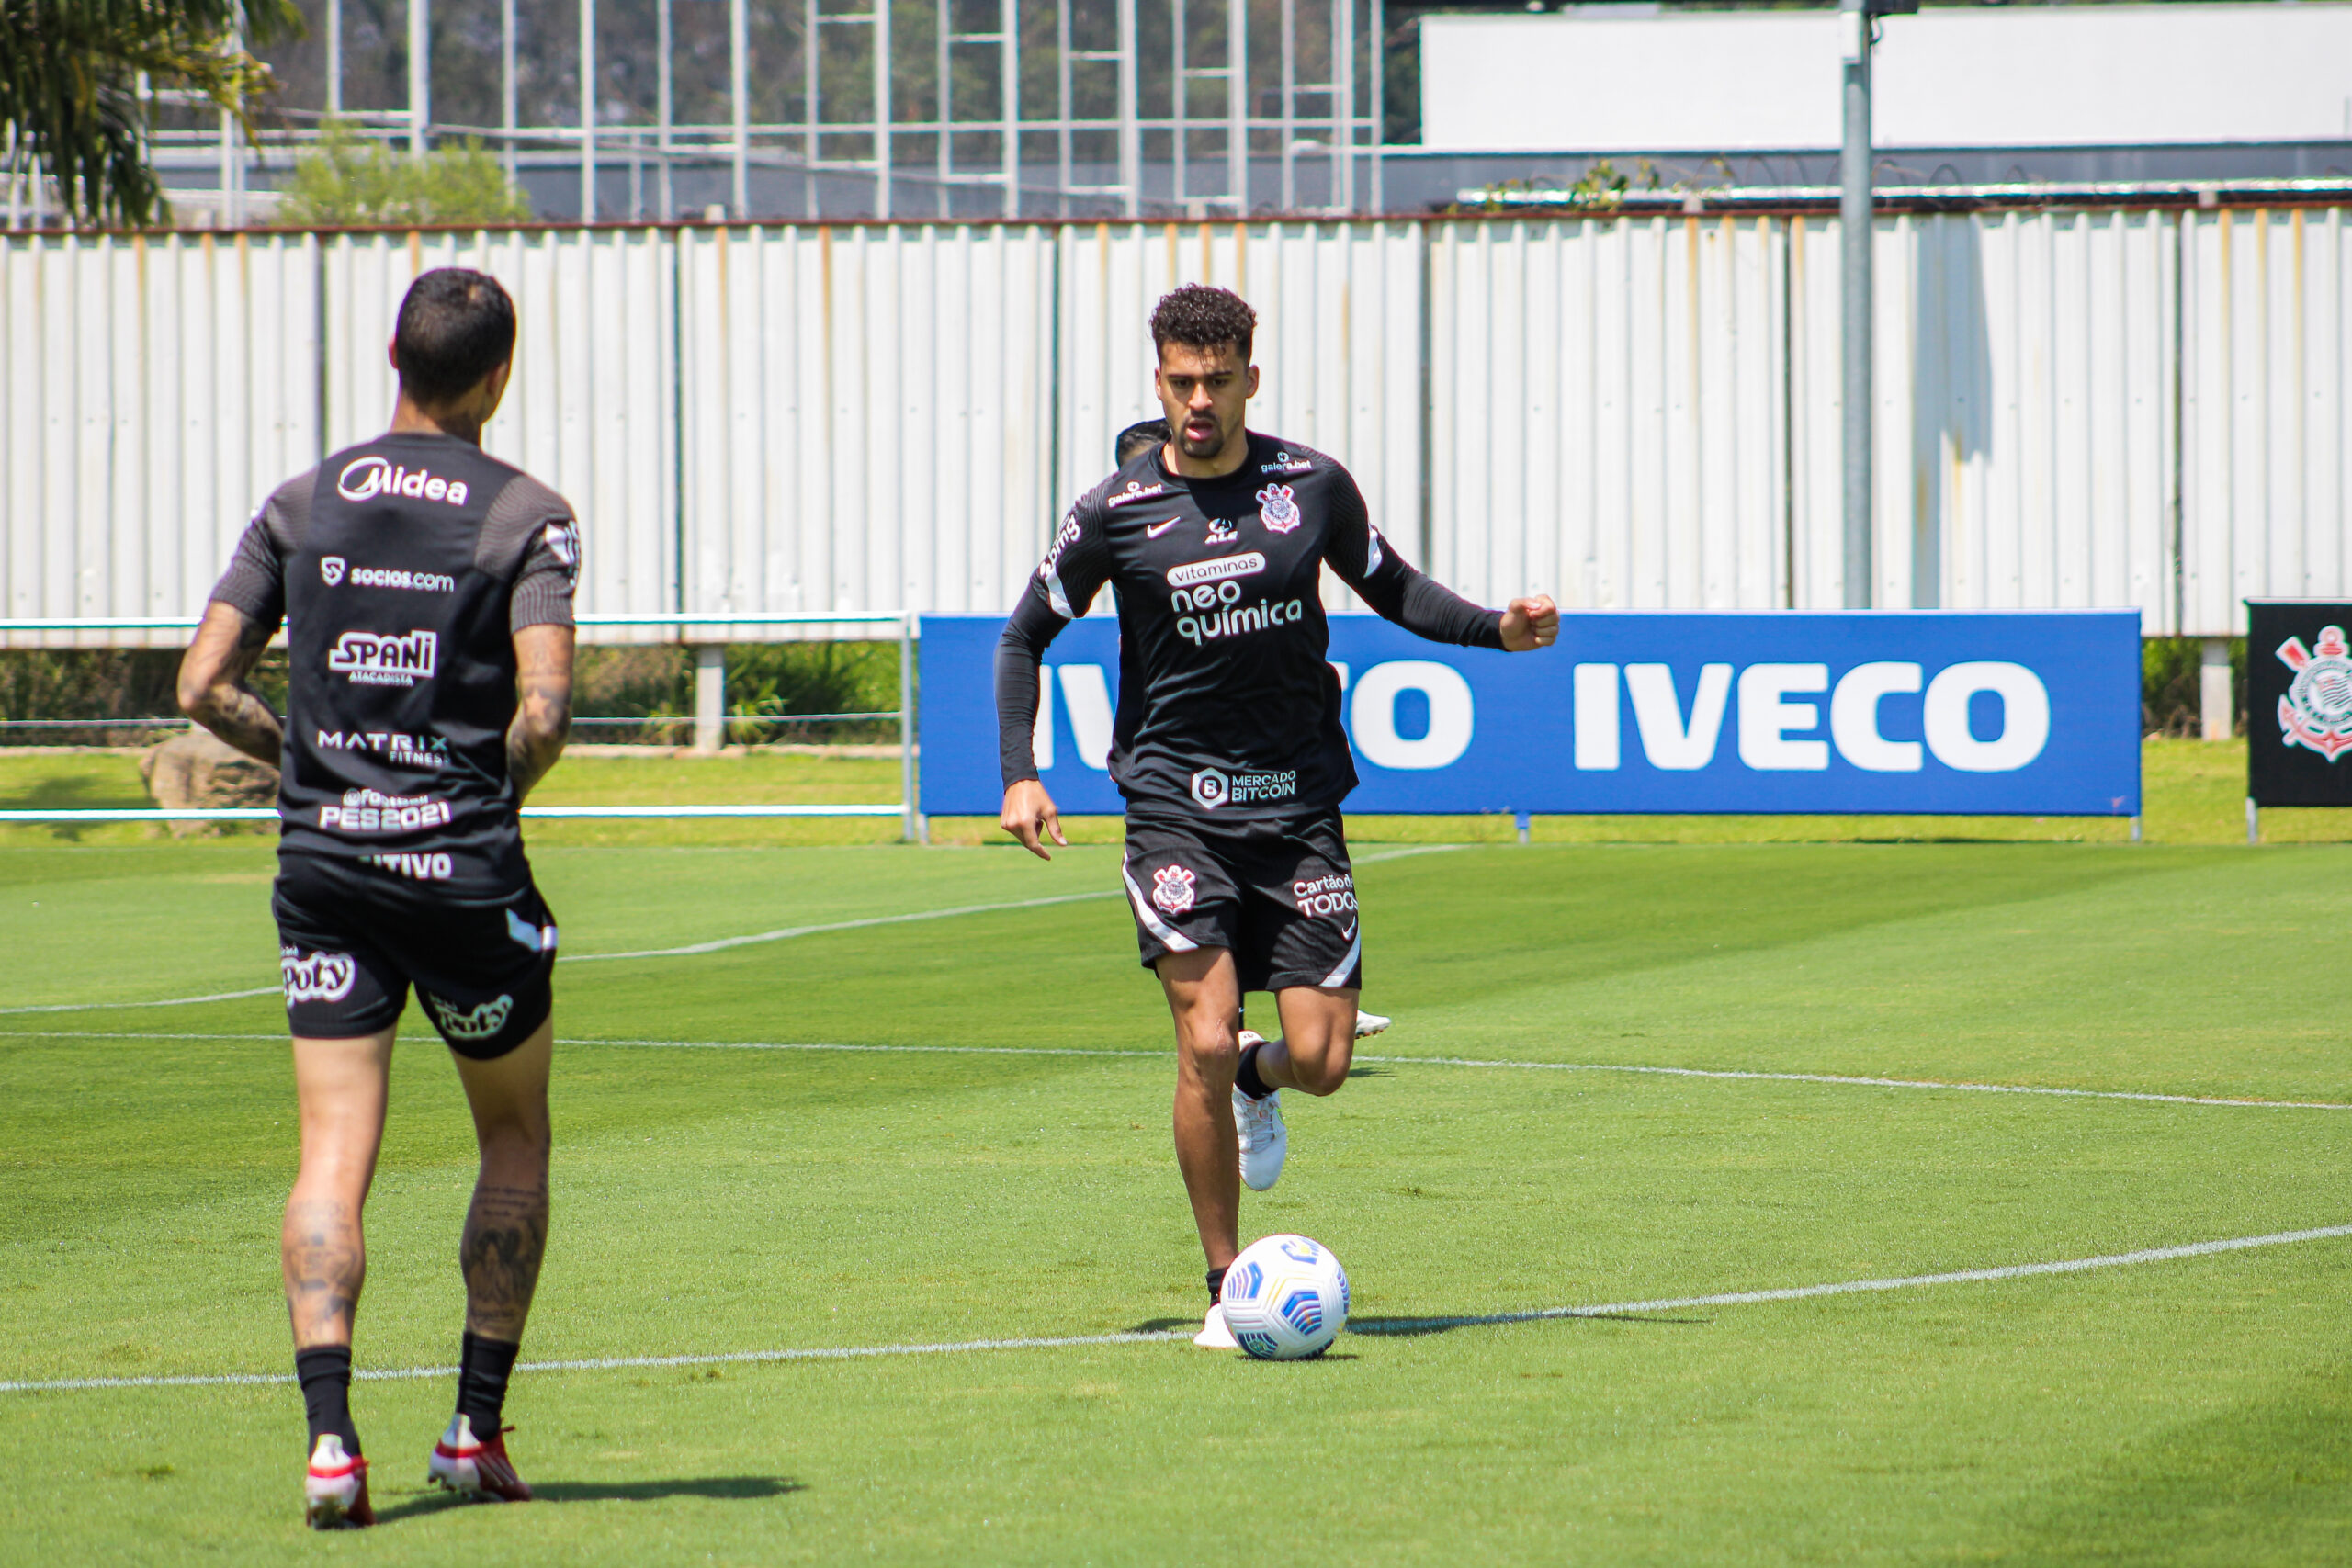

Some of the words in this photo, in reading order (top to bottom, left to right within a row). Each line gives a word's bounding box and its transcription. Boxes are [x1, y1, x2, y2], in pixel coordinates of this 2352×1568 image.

[1261, 460, 1312, 473] galera.bet
[337, 456, 469, 505] Midea
[1107, 481, 1163, 508] galera.bet
[1204, 530, 1238, 545] ALE
[350, 567, 455, 592] socios.com
[1174, 557, 1258, 582] vitaminas
[1170, 580, 1241, 613] neo
[1176, 598, 1302, 646] química
[349, 671, 413, 686] ATACADISTA
[1573, 660, 2051, 773] IVECO
[318, 730, 447, 752] MATRIX
[1232, 770, 1296, 787] MERCADO
[1231, 781, 1295, 802] BITCOIN
[319, 801, 451, 831] PES2021
[1294, 874, 1345, 897] Cartão
